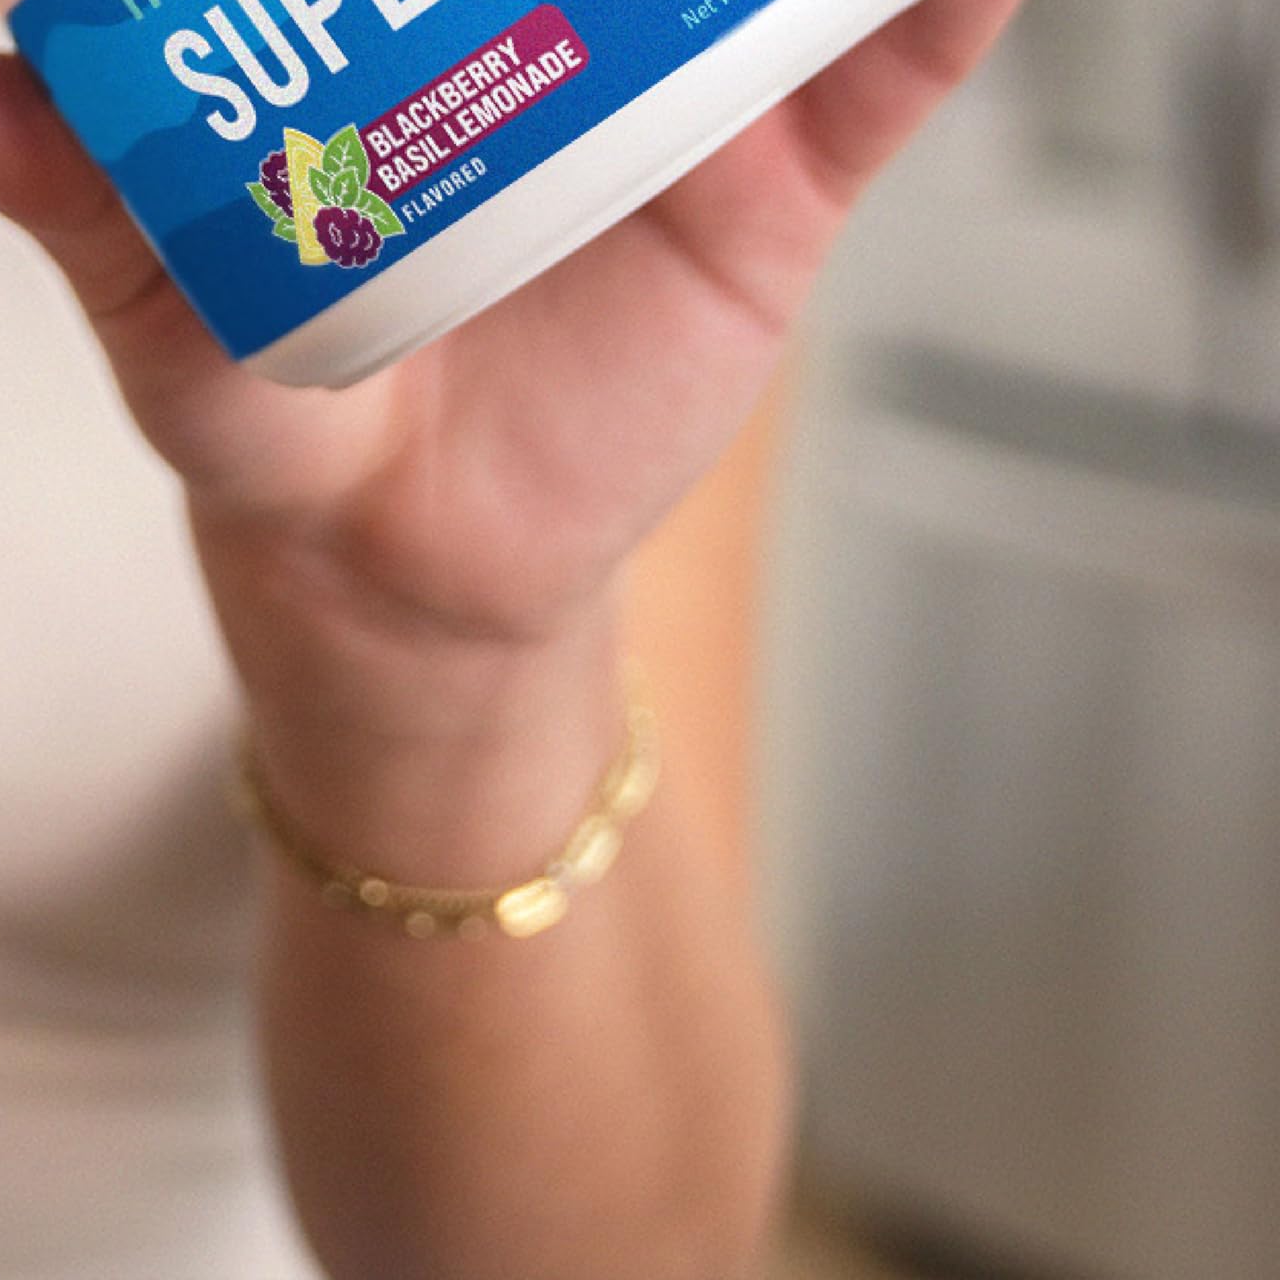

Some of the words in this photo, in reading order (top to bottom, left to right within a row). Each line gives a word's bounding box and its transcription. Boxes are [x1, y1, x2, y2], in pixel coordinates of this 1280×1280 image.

[682, 0, 718, 29] Net
[366, 36, 523, 158] BLACKBERRY
[377, 135, 452, 192] BASIL
[444, 39, 583, 147] LEMONADE
[401, 156, 488, 223] FLAVORED
